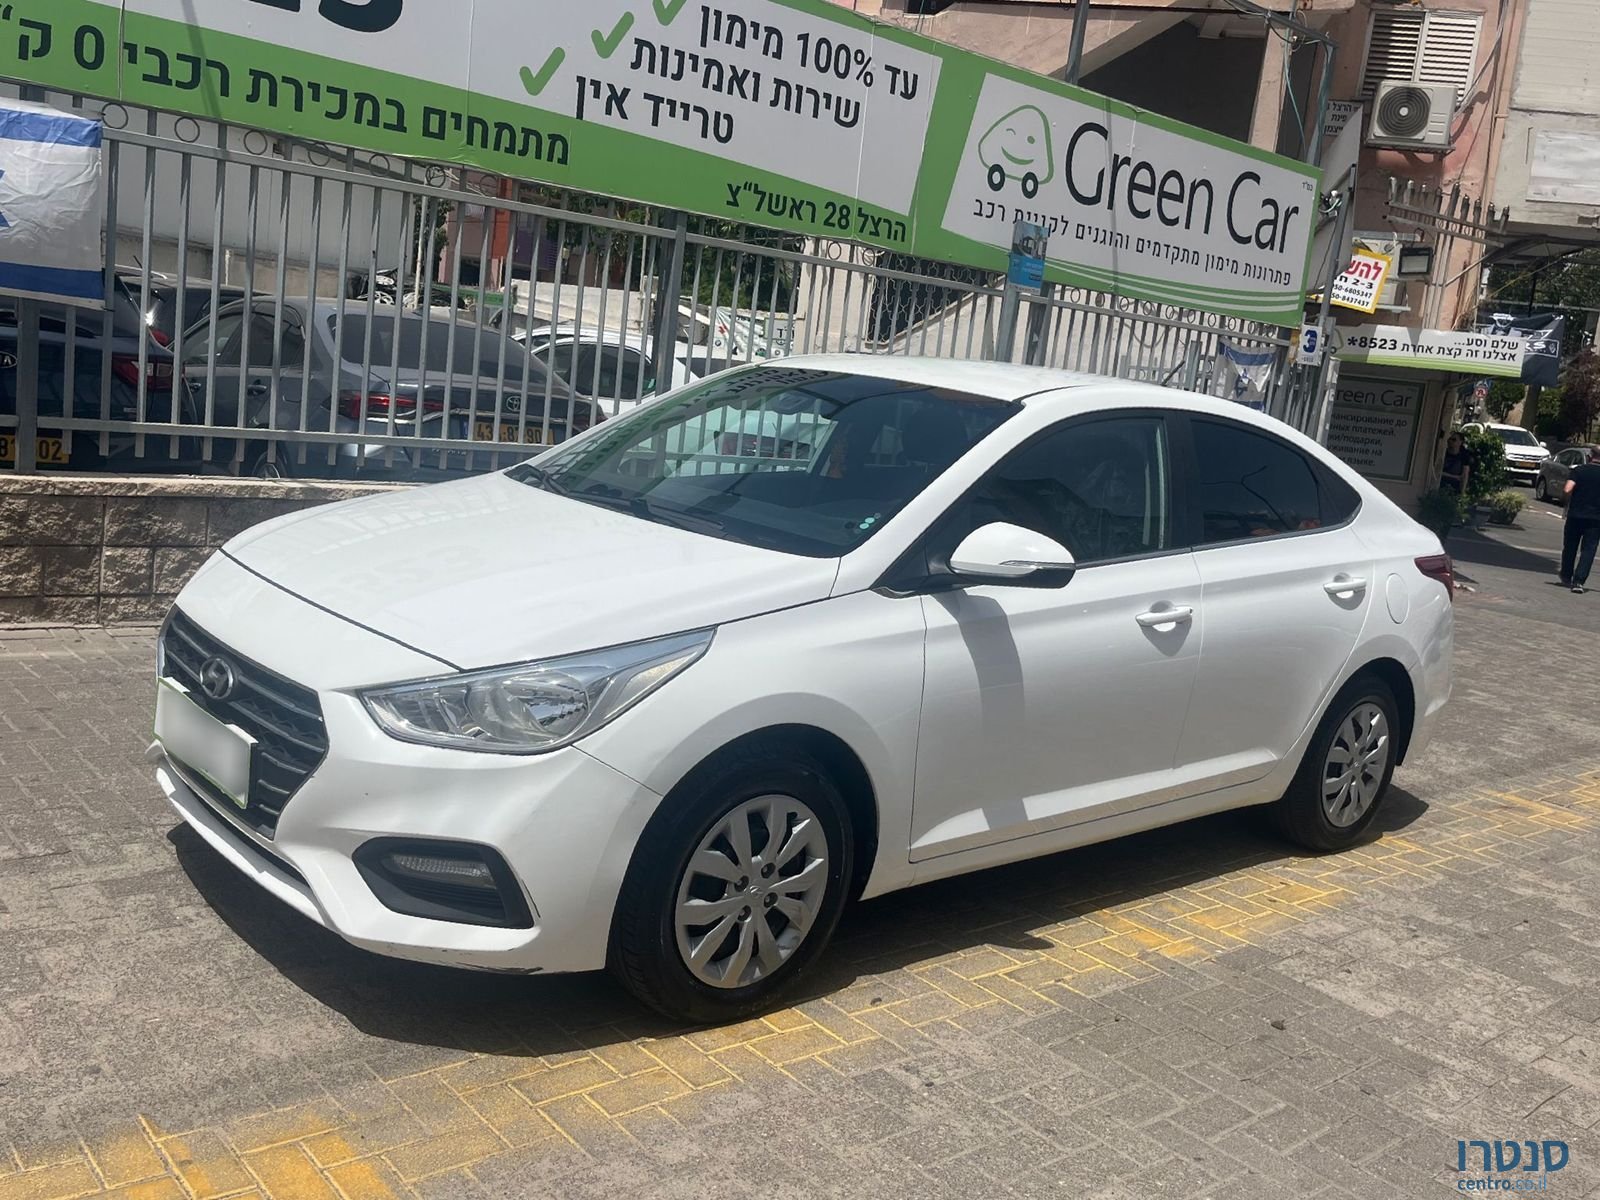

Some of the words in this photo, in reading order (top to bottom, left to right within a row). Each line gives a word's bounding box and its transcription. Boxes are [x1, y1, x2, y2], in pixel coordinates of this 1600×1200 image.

[700, 6, 784, 60] מימון
[122, 41, 230, 98] רכבי
[630, 37, 761, 103] ואמינות
[798, 33, 874, 88] 100%
[884, 63, 919, 100] עד
[245, 68, 408, 134] במכירת
[575, 75, 631, 121] אין
[769, 77, 861, 128] שירות
[643, 92, 734, 144] טרייד
[421, 105, 569, 166] מתמחים
[1066, 122, 1214, 236] Green
[1226, 171, 1300, 254] Car
[822, 200, 852, 231] 28
[857, 206, 907, 244] הרצל
[972, 197, 1006, 223] רכב
[1075, 219, 1130, 251] והוגנים
[1135, 236, 1200, 267] מתקדמים
[1204, 252, 1239, 277] מימון
[1243, 261, 1291, 287] פתרונות
[1303, 329, 1318, 353] 3
[1401, 343, 1434, 355] אחרת
[1436, 346, 1463, 359] קצת
[1465, 348, 1480, 359] זה
[1483, 349, 1516, 362] אצלנו
[1491, 338, 1519, 350] שלם
[1335, 388, 1376, 405] reen
[1380, 389, 1413, 408] Car
